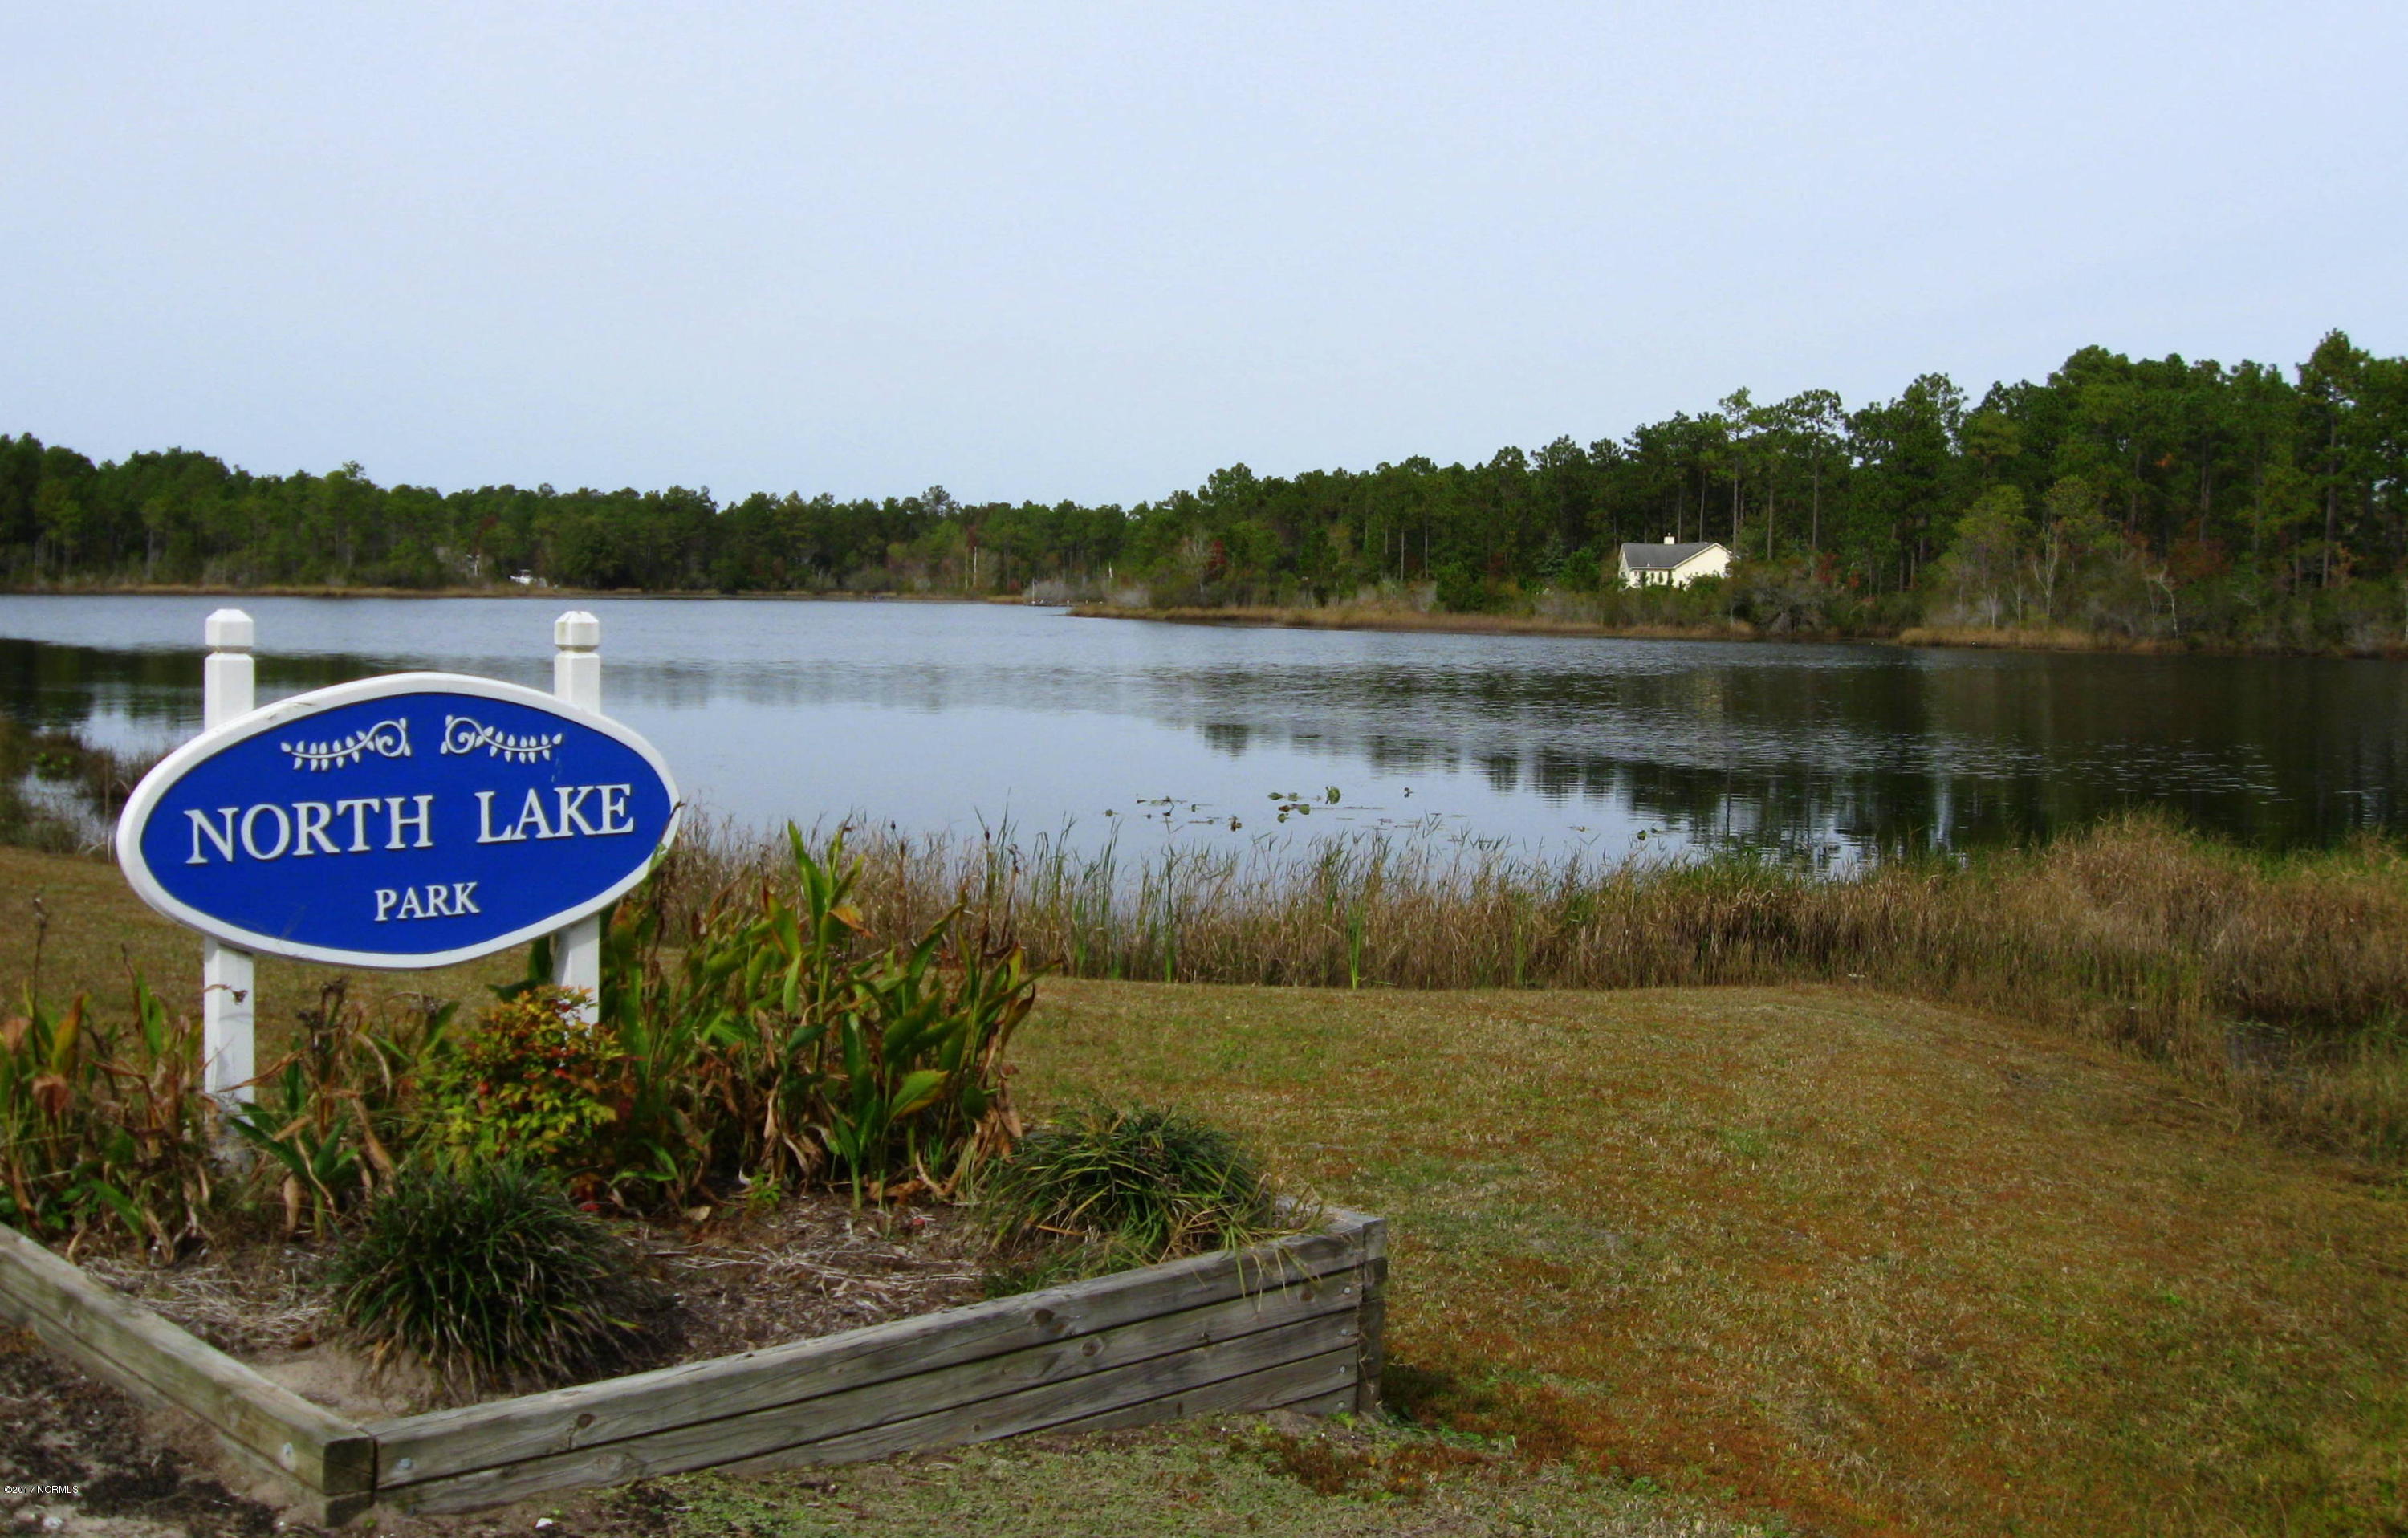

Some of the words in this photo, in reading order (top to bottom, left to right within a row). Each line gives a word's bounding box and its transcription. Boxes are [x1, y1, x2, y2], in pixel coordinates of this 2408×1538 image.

[184, 795, 434, 864] NORTH
[474, 783, 634, 843] LAKE
[374, 881, 480, 922] PARK
